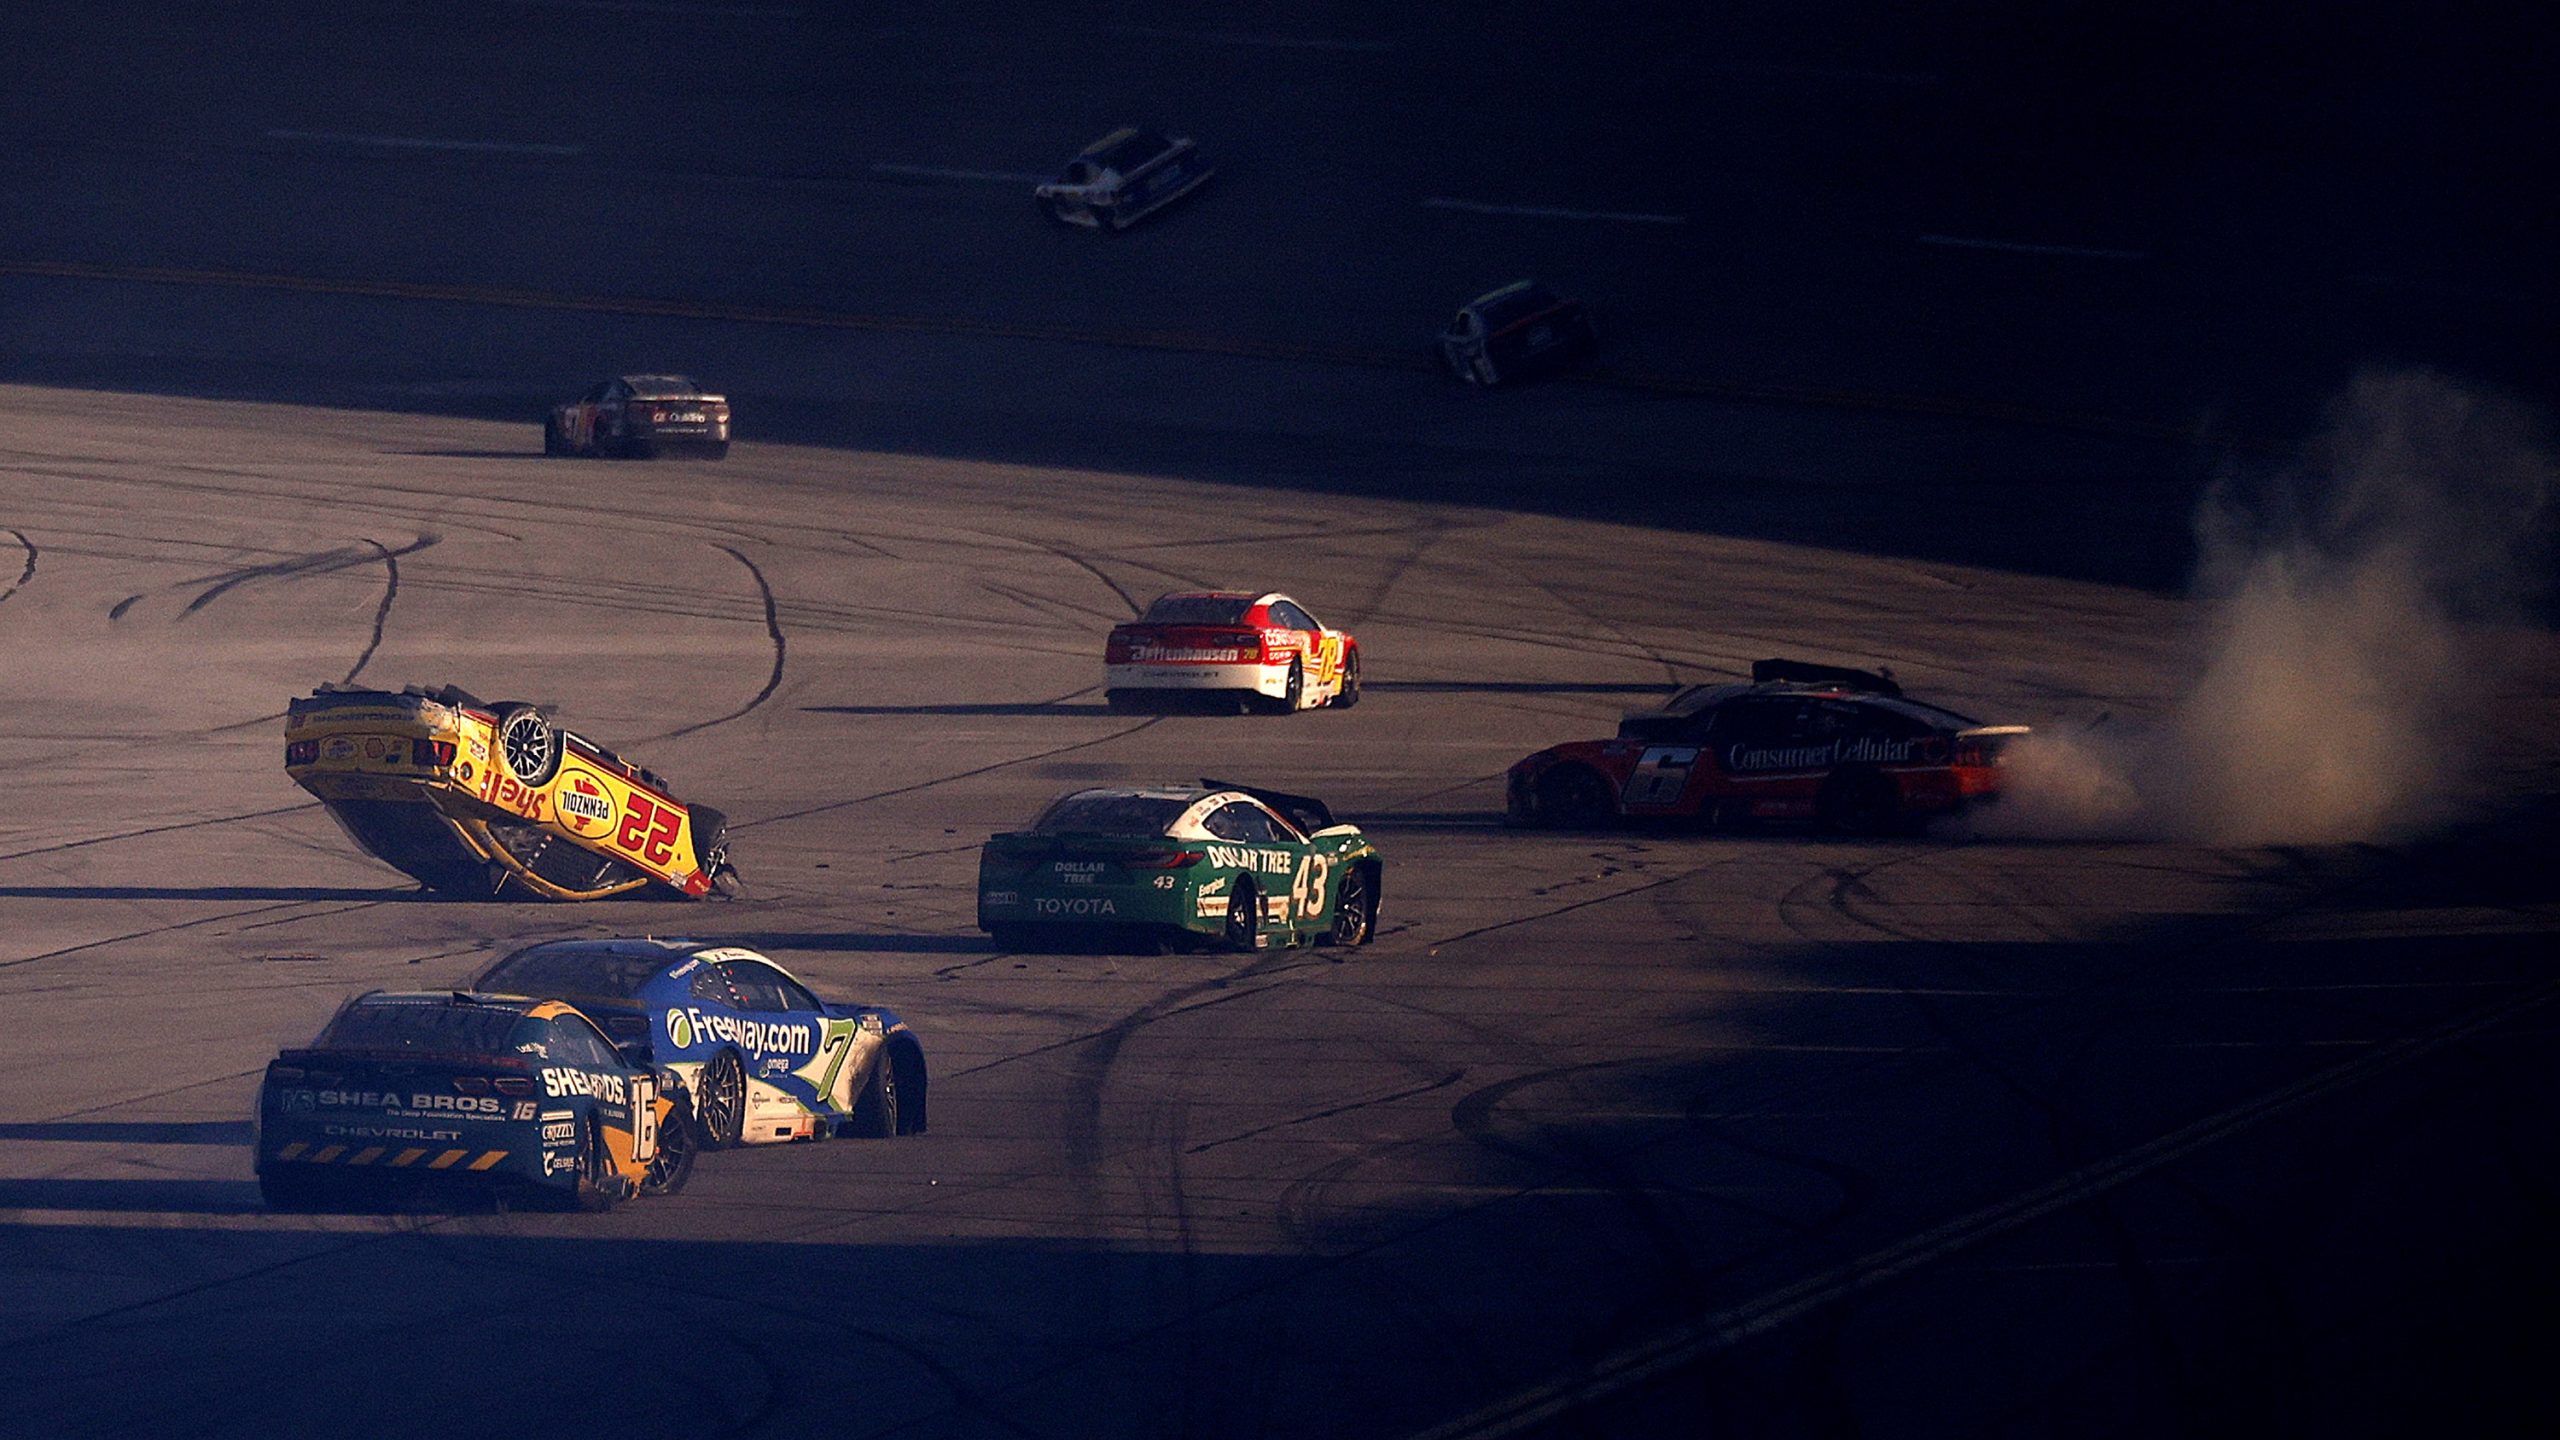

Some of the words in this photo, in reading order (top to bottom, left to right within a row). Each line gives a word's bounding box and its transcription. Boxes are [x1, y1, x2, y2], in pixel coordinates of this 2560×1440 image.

[1729, 743, 1832, 770] Consumer
[1834, 737, 1914, 764] Cellular
[1620, 744, 1700, 803] 6
[480, 769, 546, 820] Shell
[561, 791, 609, 820] PENNZOIL
[617, 792, 682, 866] 22
[1054, 861, 1105, 873] DOLLAR
[1206, 845, 1258, 872] DOLLAR
[1259, 849, 1292, 875] TREE
[1063, 873, 1096, 884] TREE
[1152, 875, 1176, 889] 43
[1292, 853, 1329, 920] 43
[1033, 898, 1116, 915] TOYOTA
[687, 1007, 810, 1060] Freeway.com
[817, 1017, 857, 1102] 7
[319, 1090, 402, 1107] SHEA
[411, 1093, 507, 1114] BROS.
[512, 1101, 538, 1121] 16
[325, 1125, 462, 1141] CHEVROLET
[630, 1074, 658, 1163] 16
